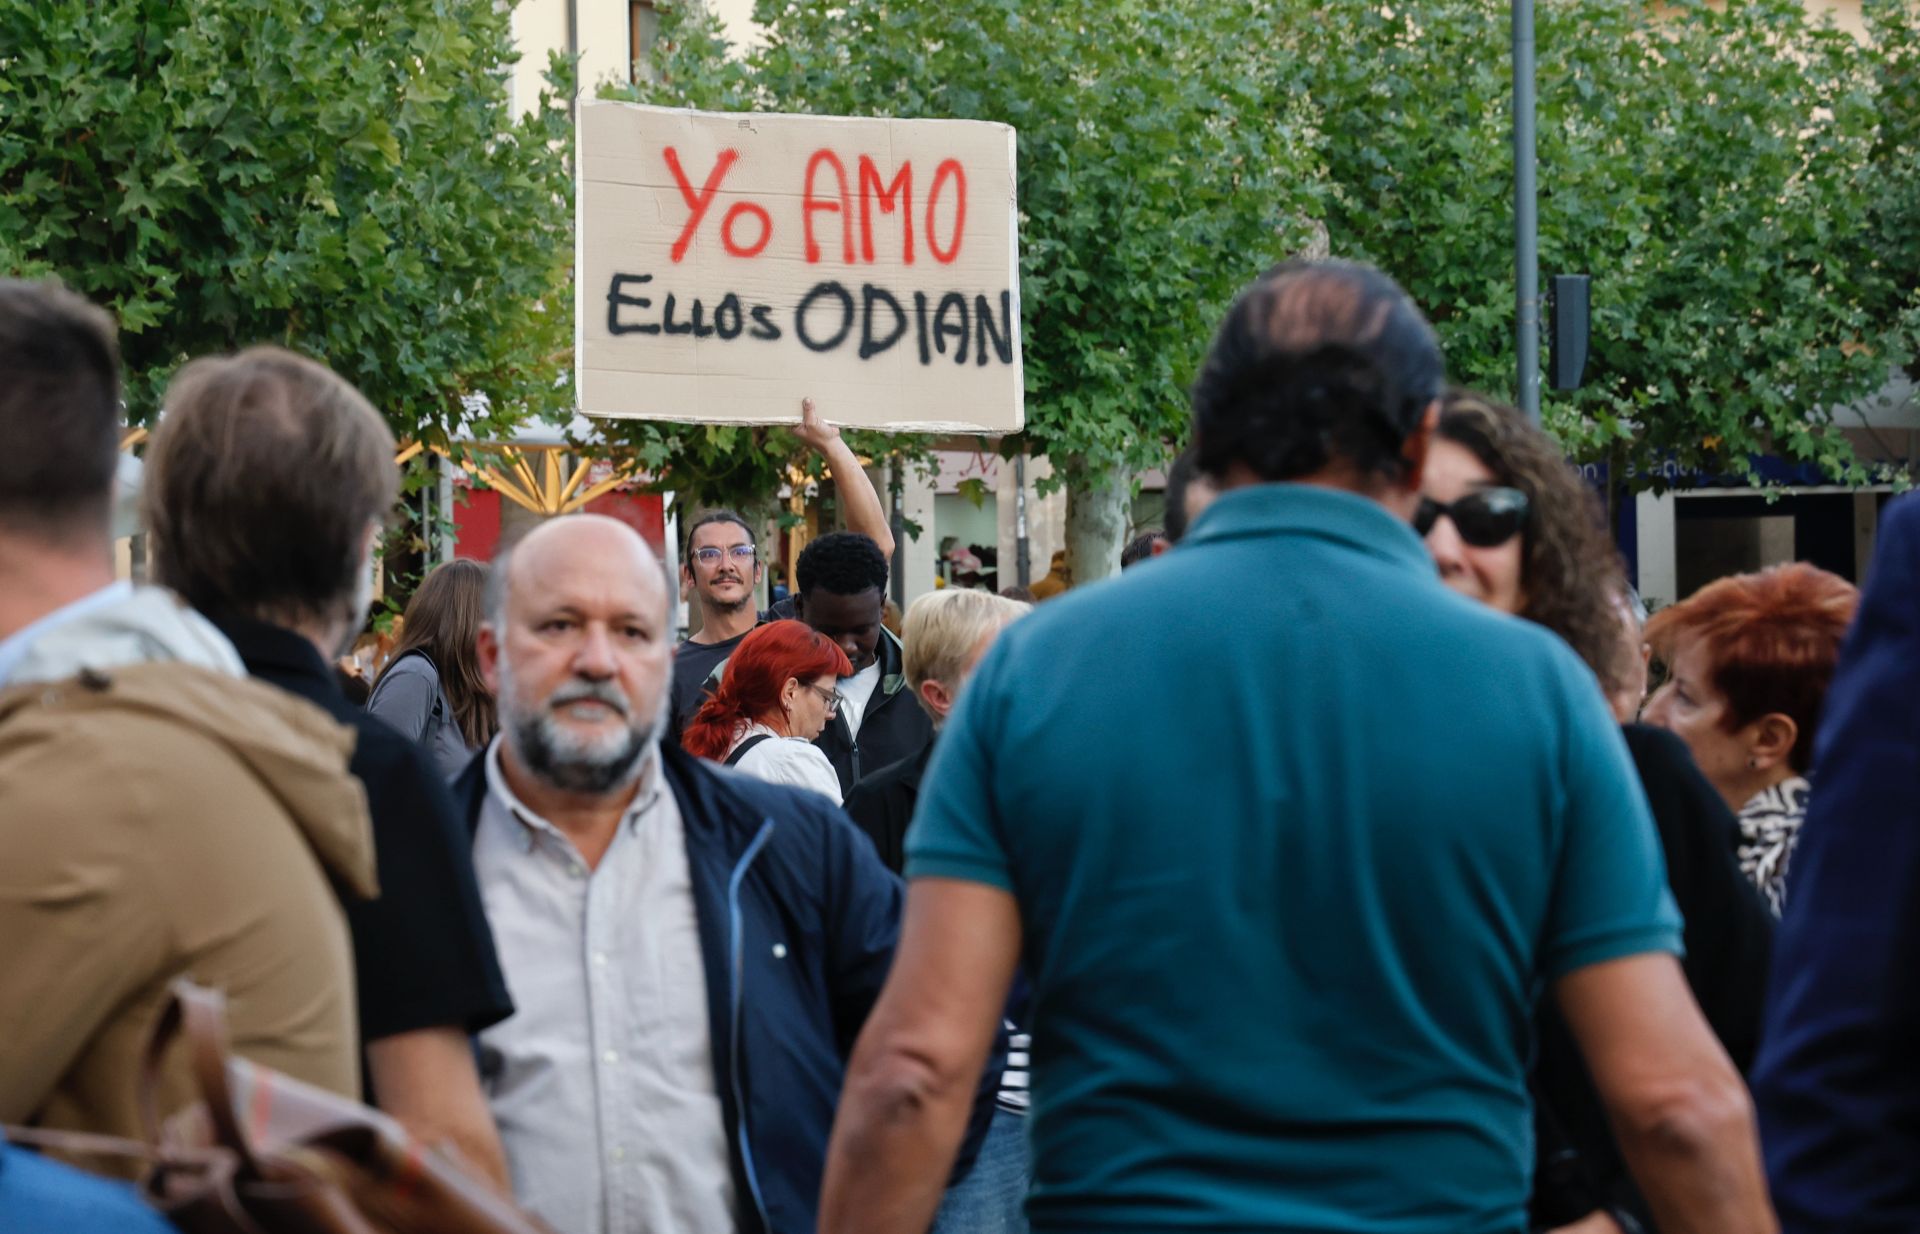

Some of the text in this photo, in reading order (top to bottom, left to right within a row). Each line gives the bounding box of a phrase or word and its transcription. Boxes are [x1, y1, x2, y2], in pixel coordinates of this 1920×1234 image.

[663, 146, 968, 265] Yo AMO
[794, 280, 1014, 366] ODIAN
